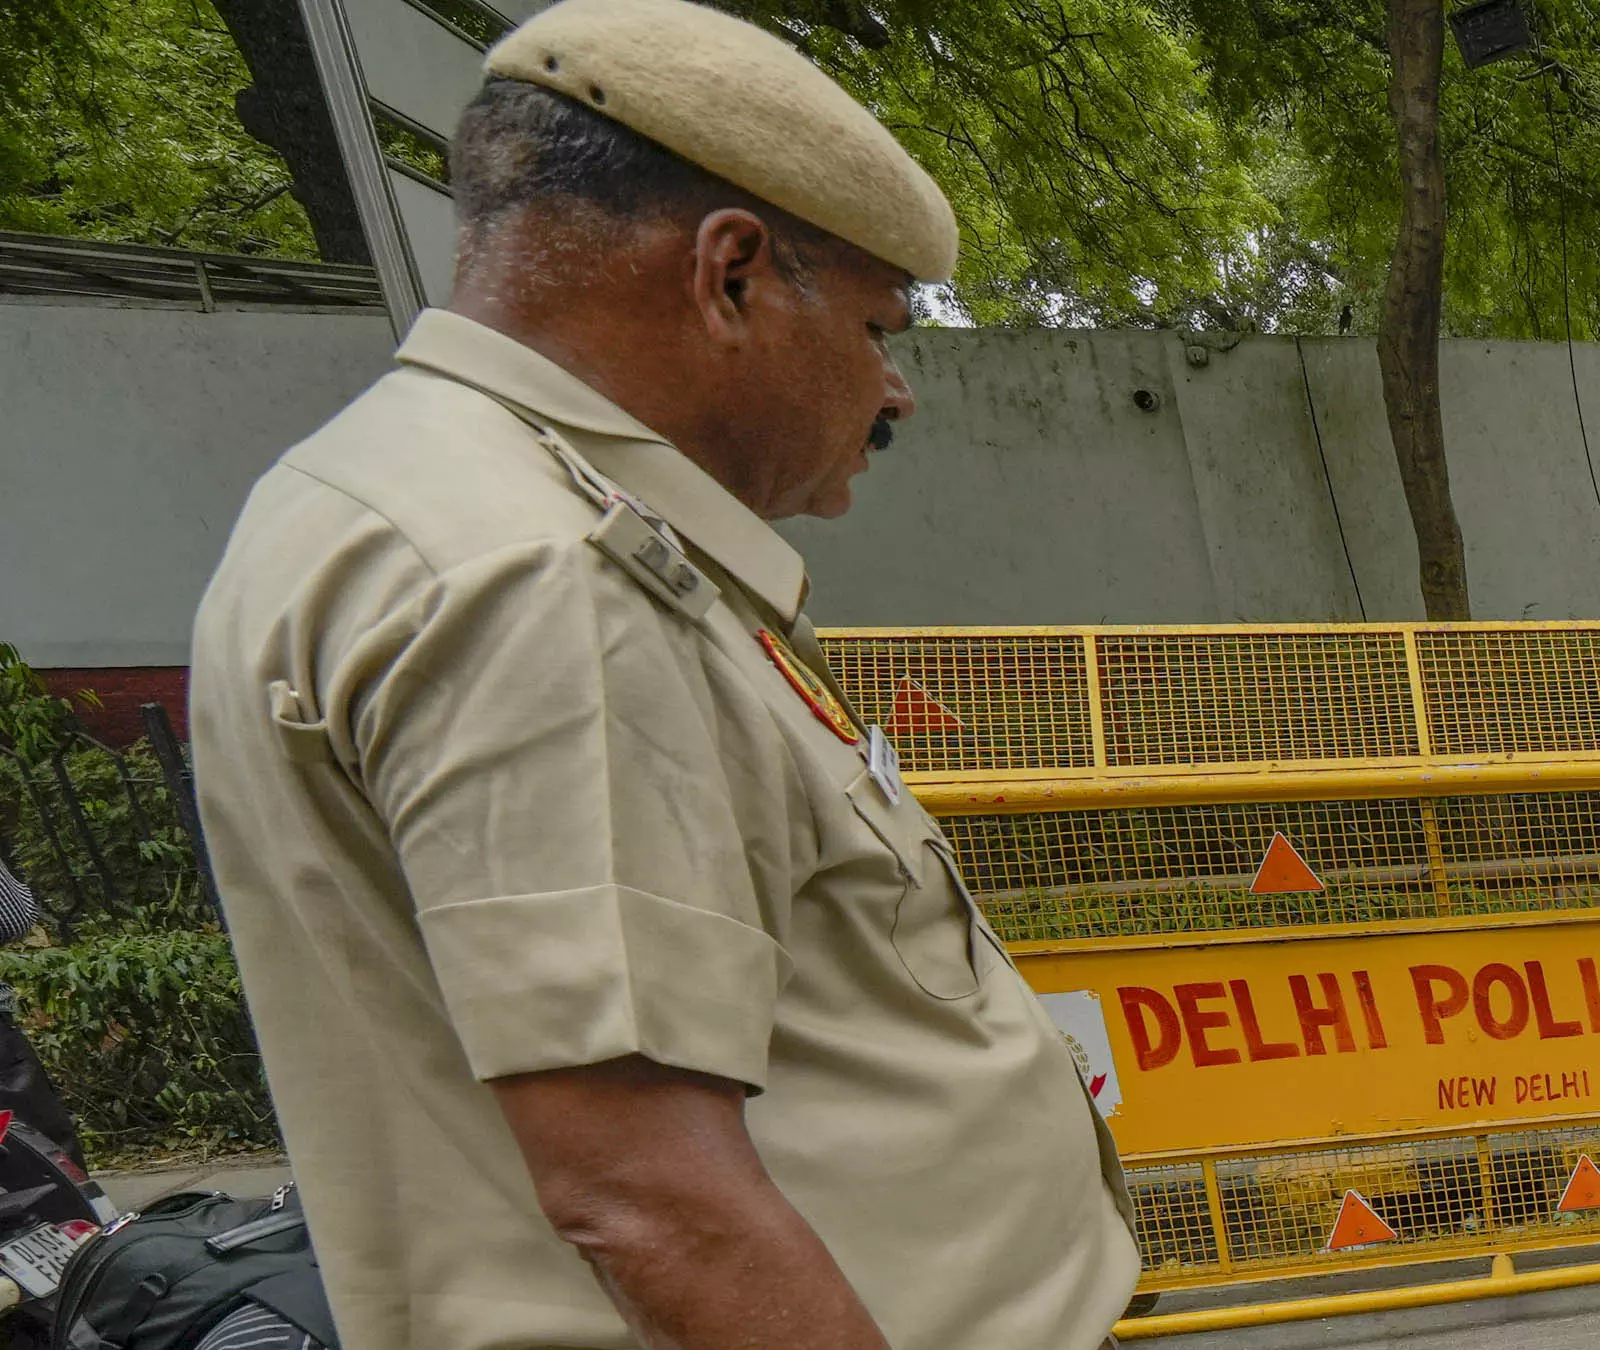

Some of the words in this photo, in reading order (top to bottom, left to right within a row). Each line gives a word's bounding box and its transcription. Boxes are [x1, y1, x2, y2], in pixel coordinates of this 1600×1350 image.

[1116, 970, 1389, 1072] DELHI
[1438, 1076, 1497, 1110] NEW
[1514, 1069, 1591, 1104] DELHI
